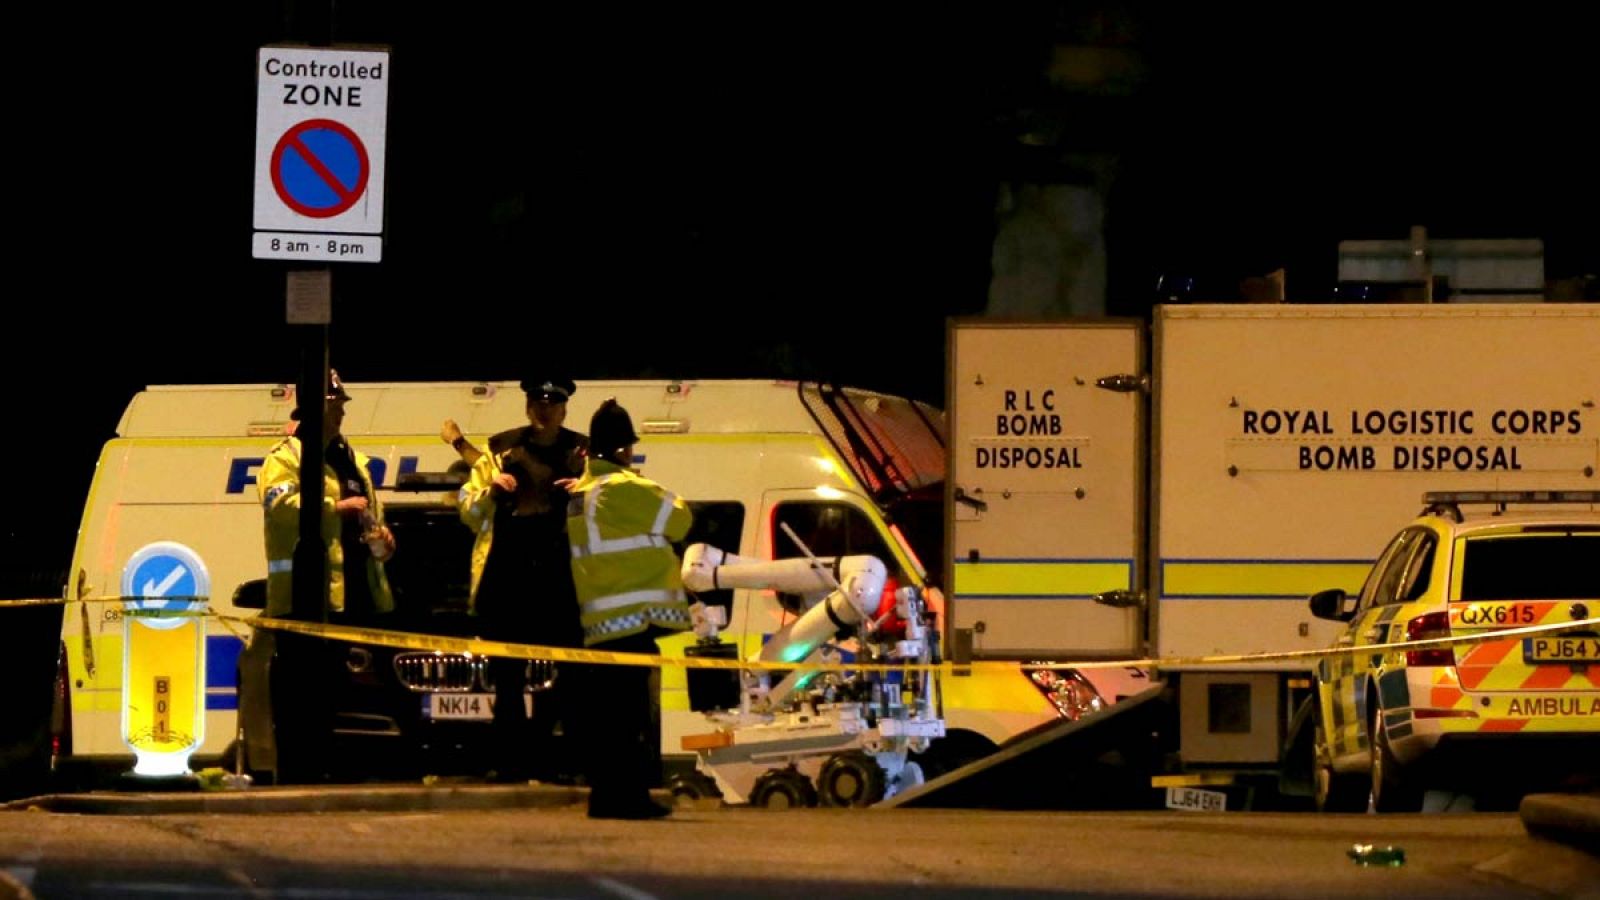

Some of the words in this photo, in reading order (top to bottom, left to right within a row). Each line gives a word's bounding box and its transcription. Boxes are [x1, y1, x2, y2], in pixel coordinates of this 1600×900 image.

[265, 58, 383, 80] Controlled
[283, 84, 362, 107] ZONE
[997, 414, 1062, 436] BOMB
[1243, 410, 1333, 434] ROYAL
[1352, 410, 1474, 434] LOGISTIC
[1491, 410, 1582, 434] CORPS
[976, 447, 1082, 469] DISPOSAL
[1299, 446, 1376, 470] BOMB
[1393, 446, 1522, 470] DISPOSAL
[1460, 605, 1535, 625] QX615
[1536, 640, 1587, 658] PJ64
[438, 697, 481, 714] NK14
